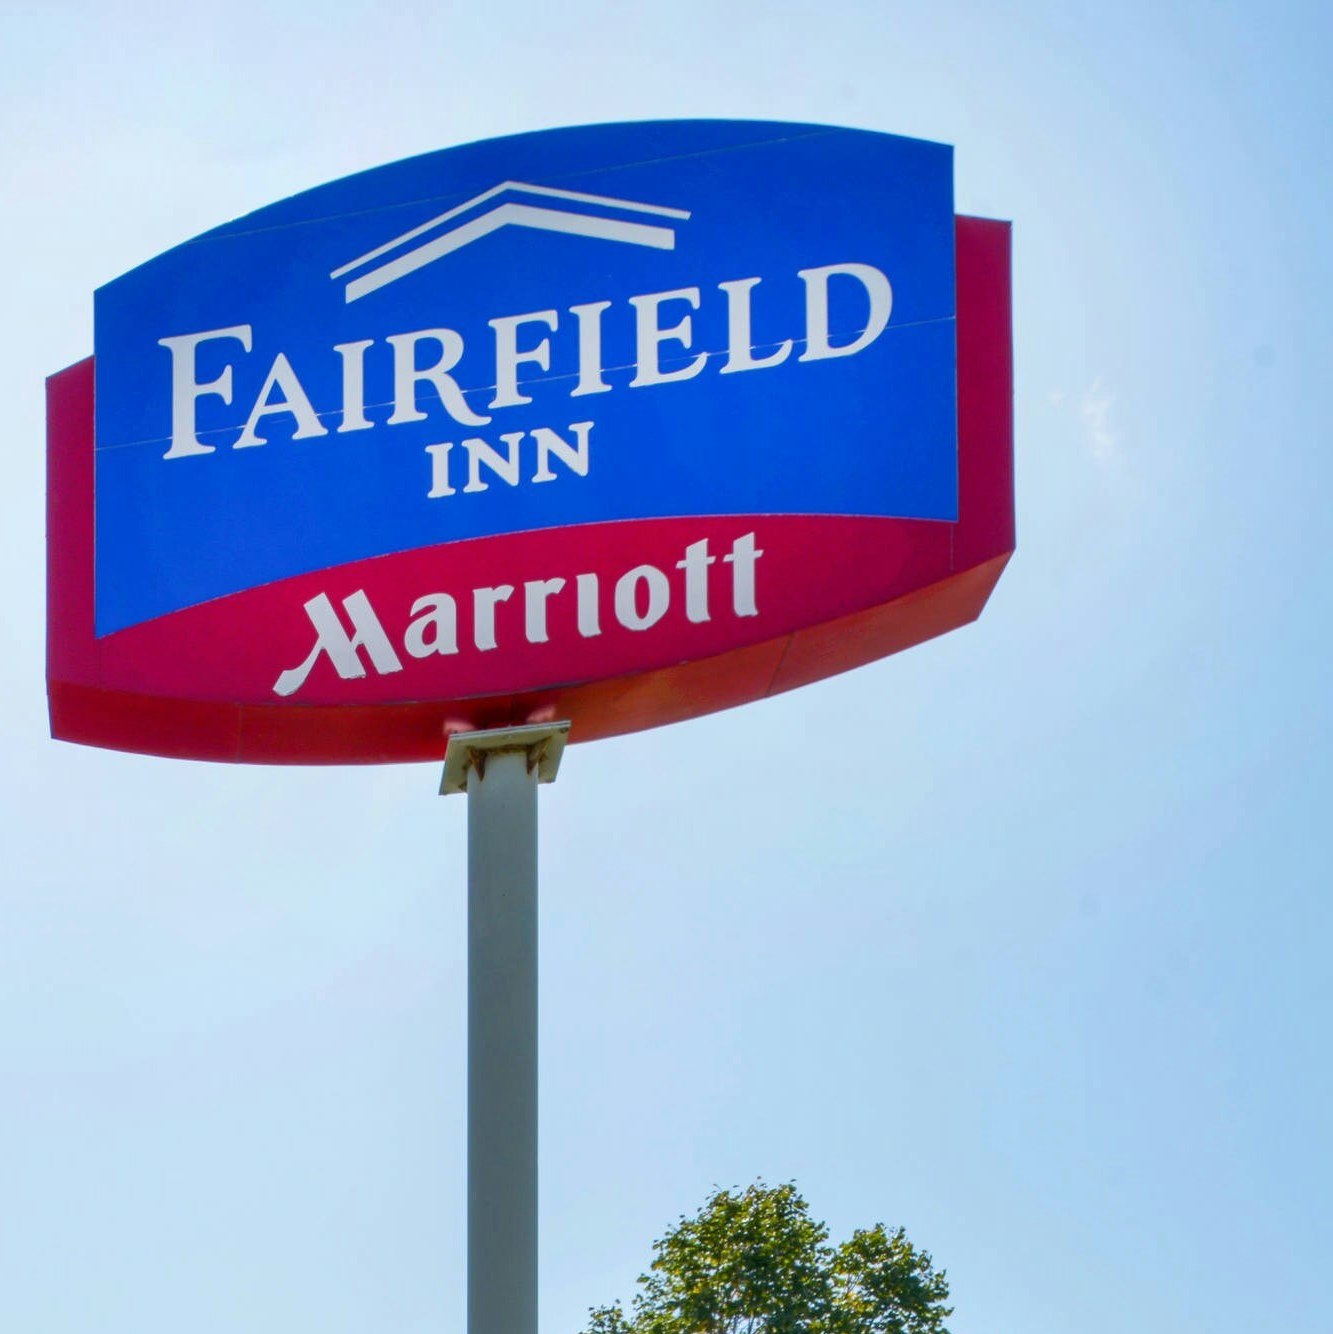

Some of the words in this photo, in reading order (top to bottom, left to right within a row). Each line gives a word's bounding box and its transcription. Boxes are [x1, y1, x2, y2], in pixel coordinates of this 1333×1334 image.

[158, 262, 893, 460] FAIRFIELD
[425, 421, 595, 499] INN
[272, 532, 764, 697] Marriott
